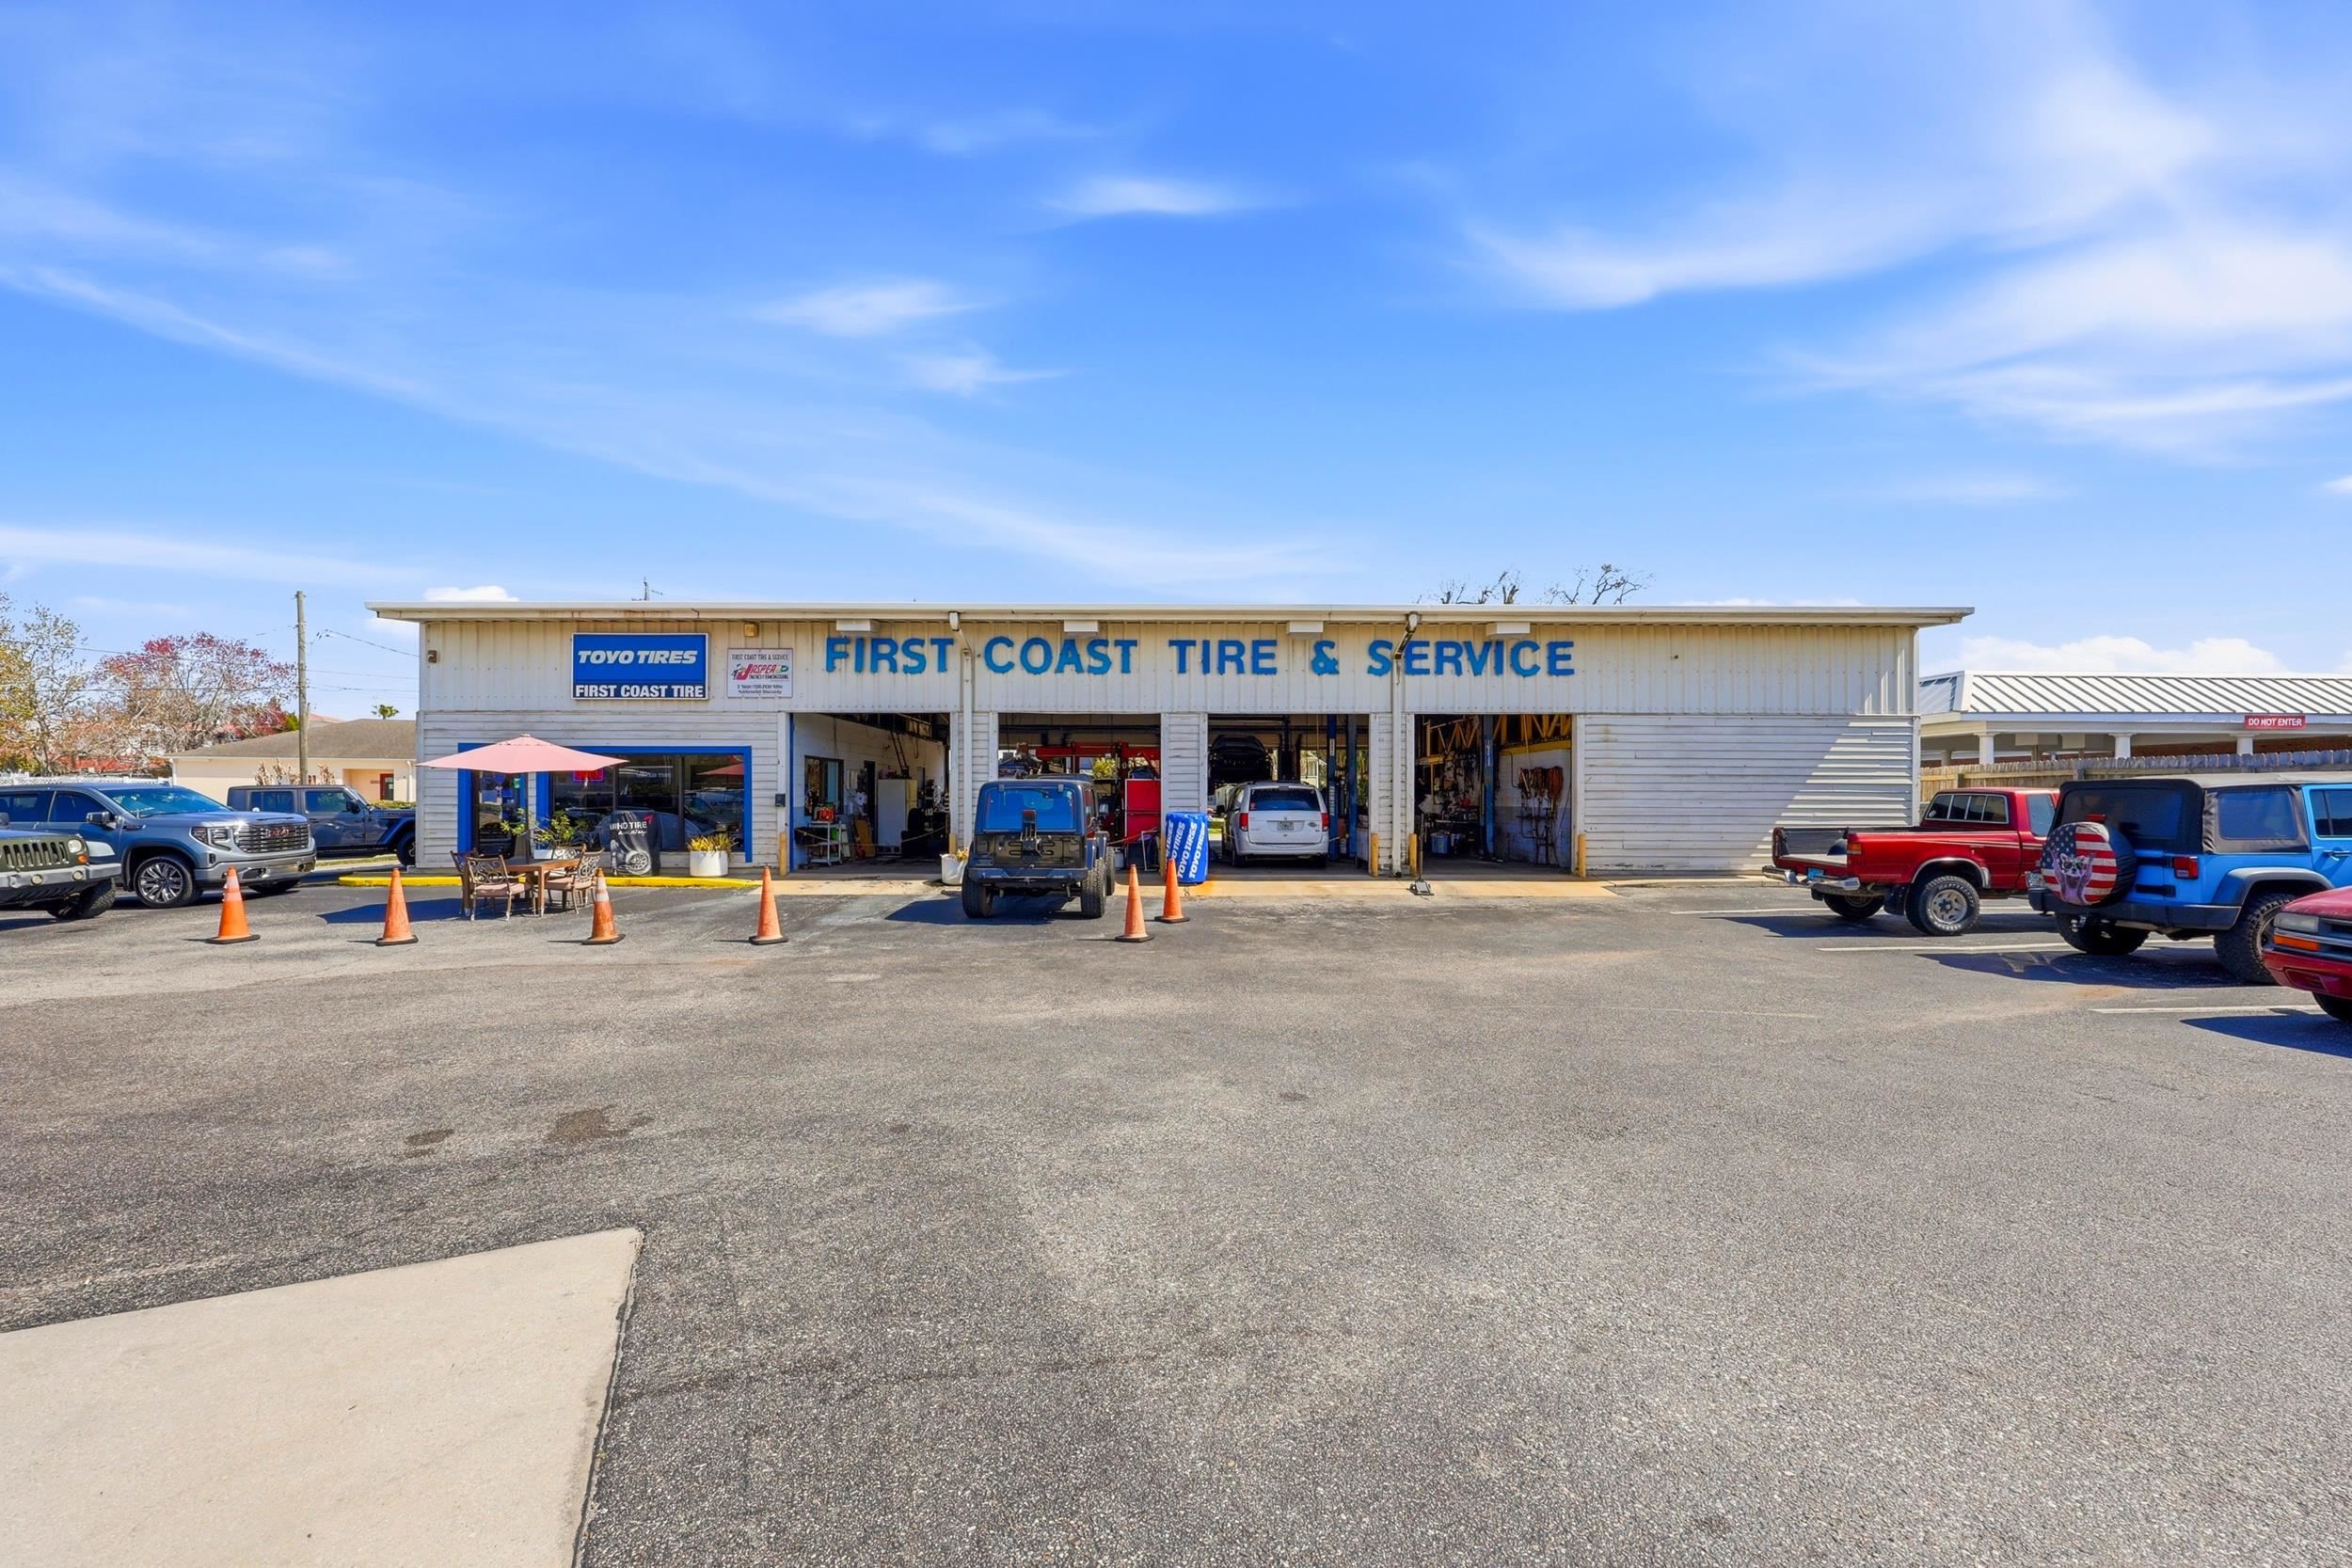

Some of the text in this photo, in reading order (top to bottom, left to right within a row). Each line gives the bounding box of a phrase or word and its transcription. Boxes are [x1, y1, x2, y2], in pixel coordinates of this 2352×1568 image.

[578, 650, 698, 664] TOYO TIRES
[825, 636, 1575, 677] FIRST COAST TIRE & SERVICE
[575, 685, 704, 697] FIRST COAST TIRE
[2249, 718, 2302, 726] DO NOT ENTER
[1173, 821, 1185, 850] TIRES
[1178, 821, 1198, 879] TOYO TIRES
[1189, 850, 1201, 879] TOYO
